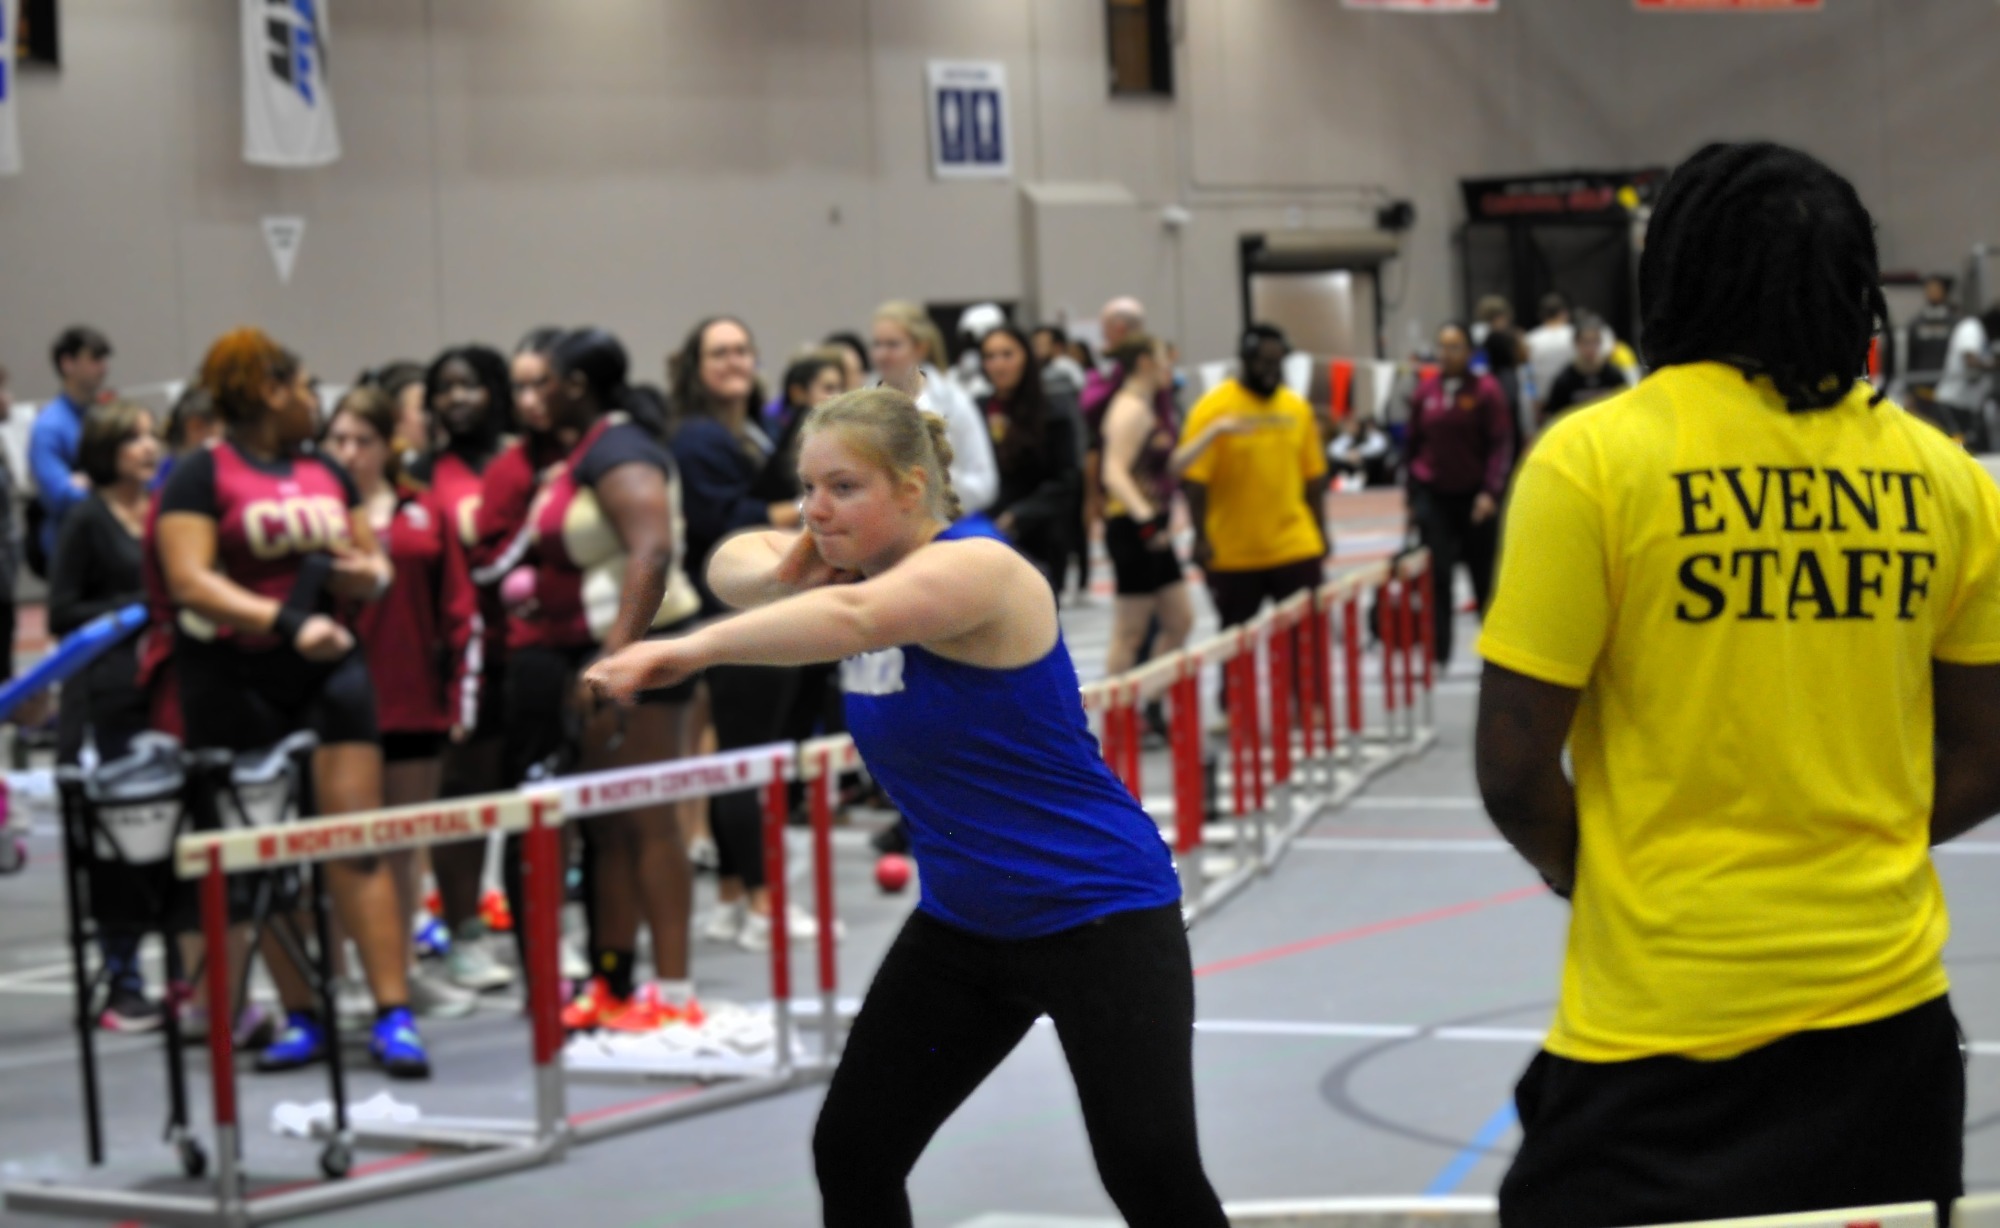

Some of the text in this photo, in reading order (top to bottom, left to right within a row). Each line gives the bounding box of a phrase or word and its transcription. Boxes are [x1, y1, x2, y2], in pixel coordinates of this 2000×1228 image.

[1670, 465, 1931, 537] EVENT
[1675, 547, 1937, 624] STAFF
[600, 765, 728, 802] NORTH CENTRAL
[285, 811, 472, 854] NORTH CENTRAL
